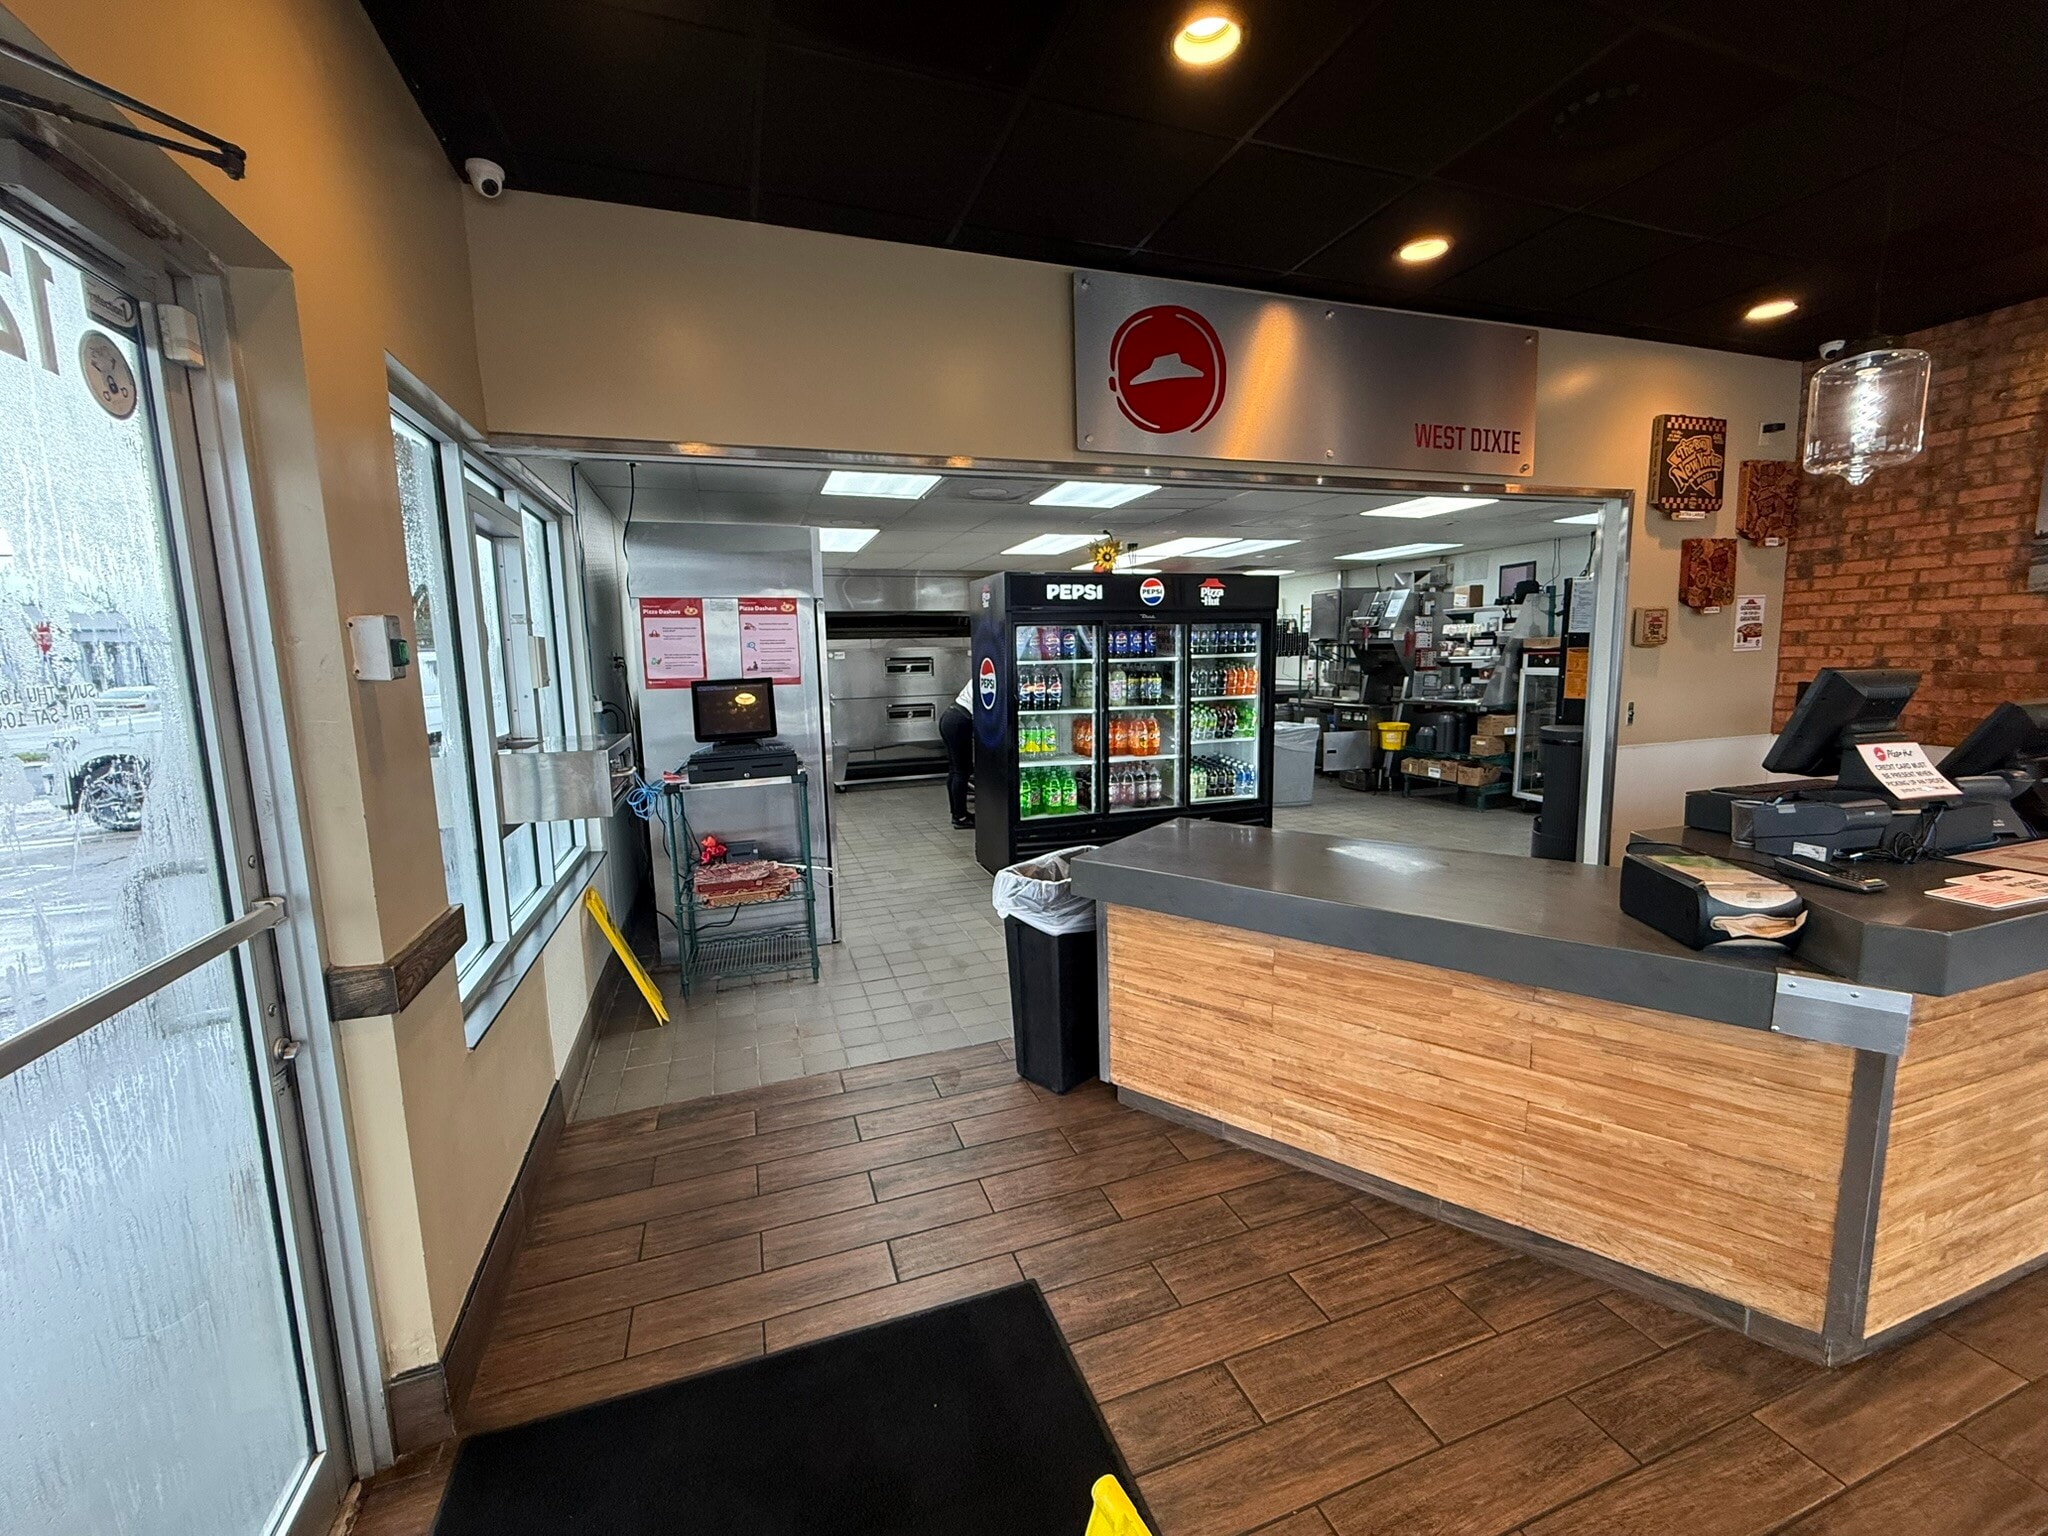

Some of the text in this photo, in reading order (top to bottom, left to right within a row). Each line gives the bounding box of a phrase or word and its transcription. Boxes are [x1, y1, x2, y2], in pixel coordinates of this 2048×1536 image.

[1415, 423, 1521, 454] WEST DIXIE
[1677, 445, 1694, 459] The
[1672, 458, 1700, 488] New
[1697, 473, 1713, 484] PIZZA
[1046, 584, 1103, 600] PEPSI
[1142, 588, 1163, 596] PEPSI
[1200, 586, 1224, 598] Pizza
[1200, 595, 1220, 606] Hut
[980, 678, 995, 690] PEPSI
[1875, 763, 1895, 771] CREDIT
